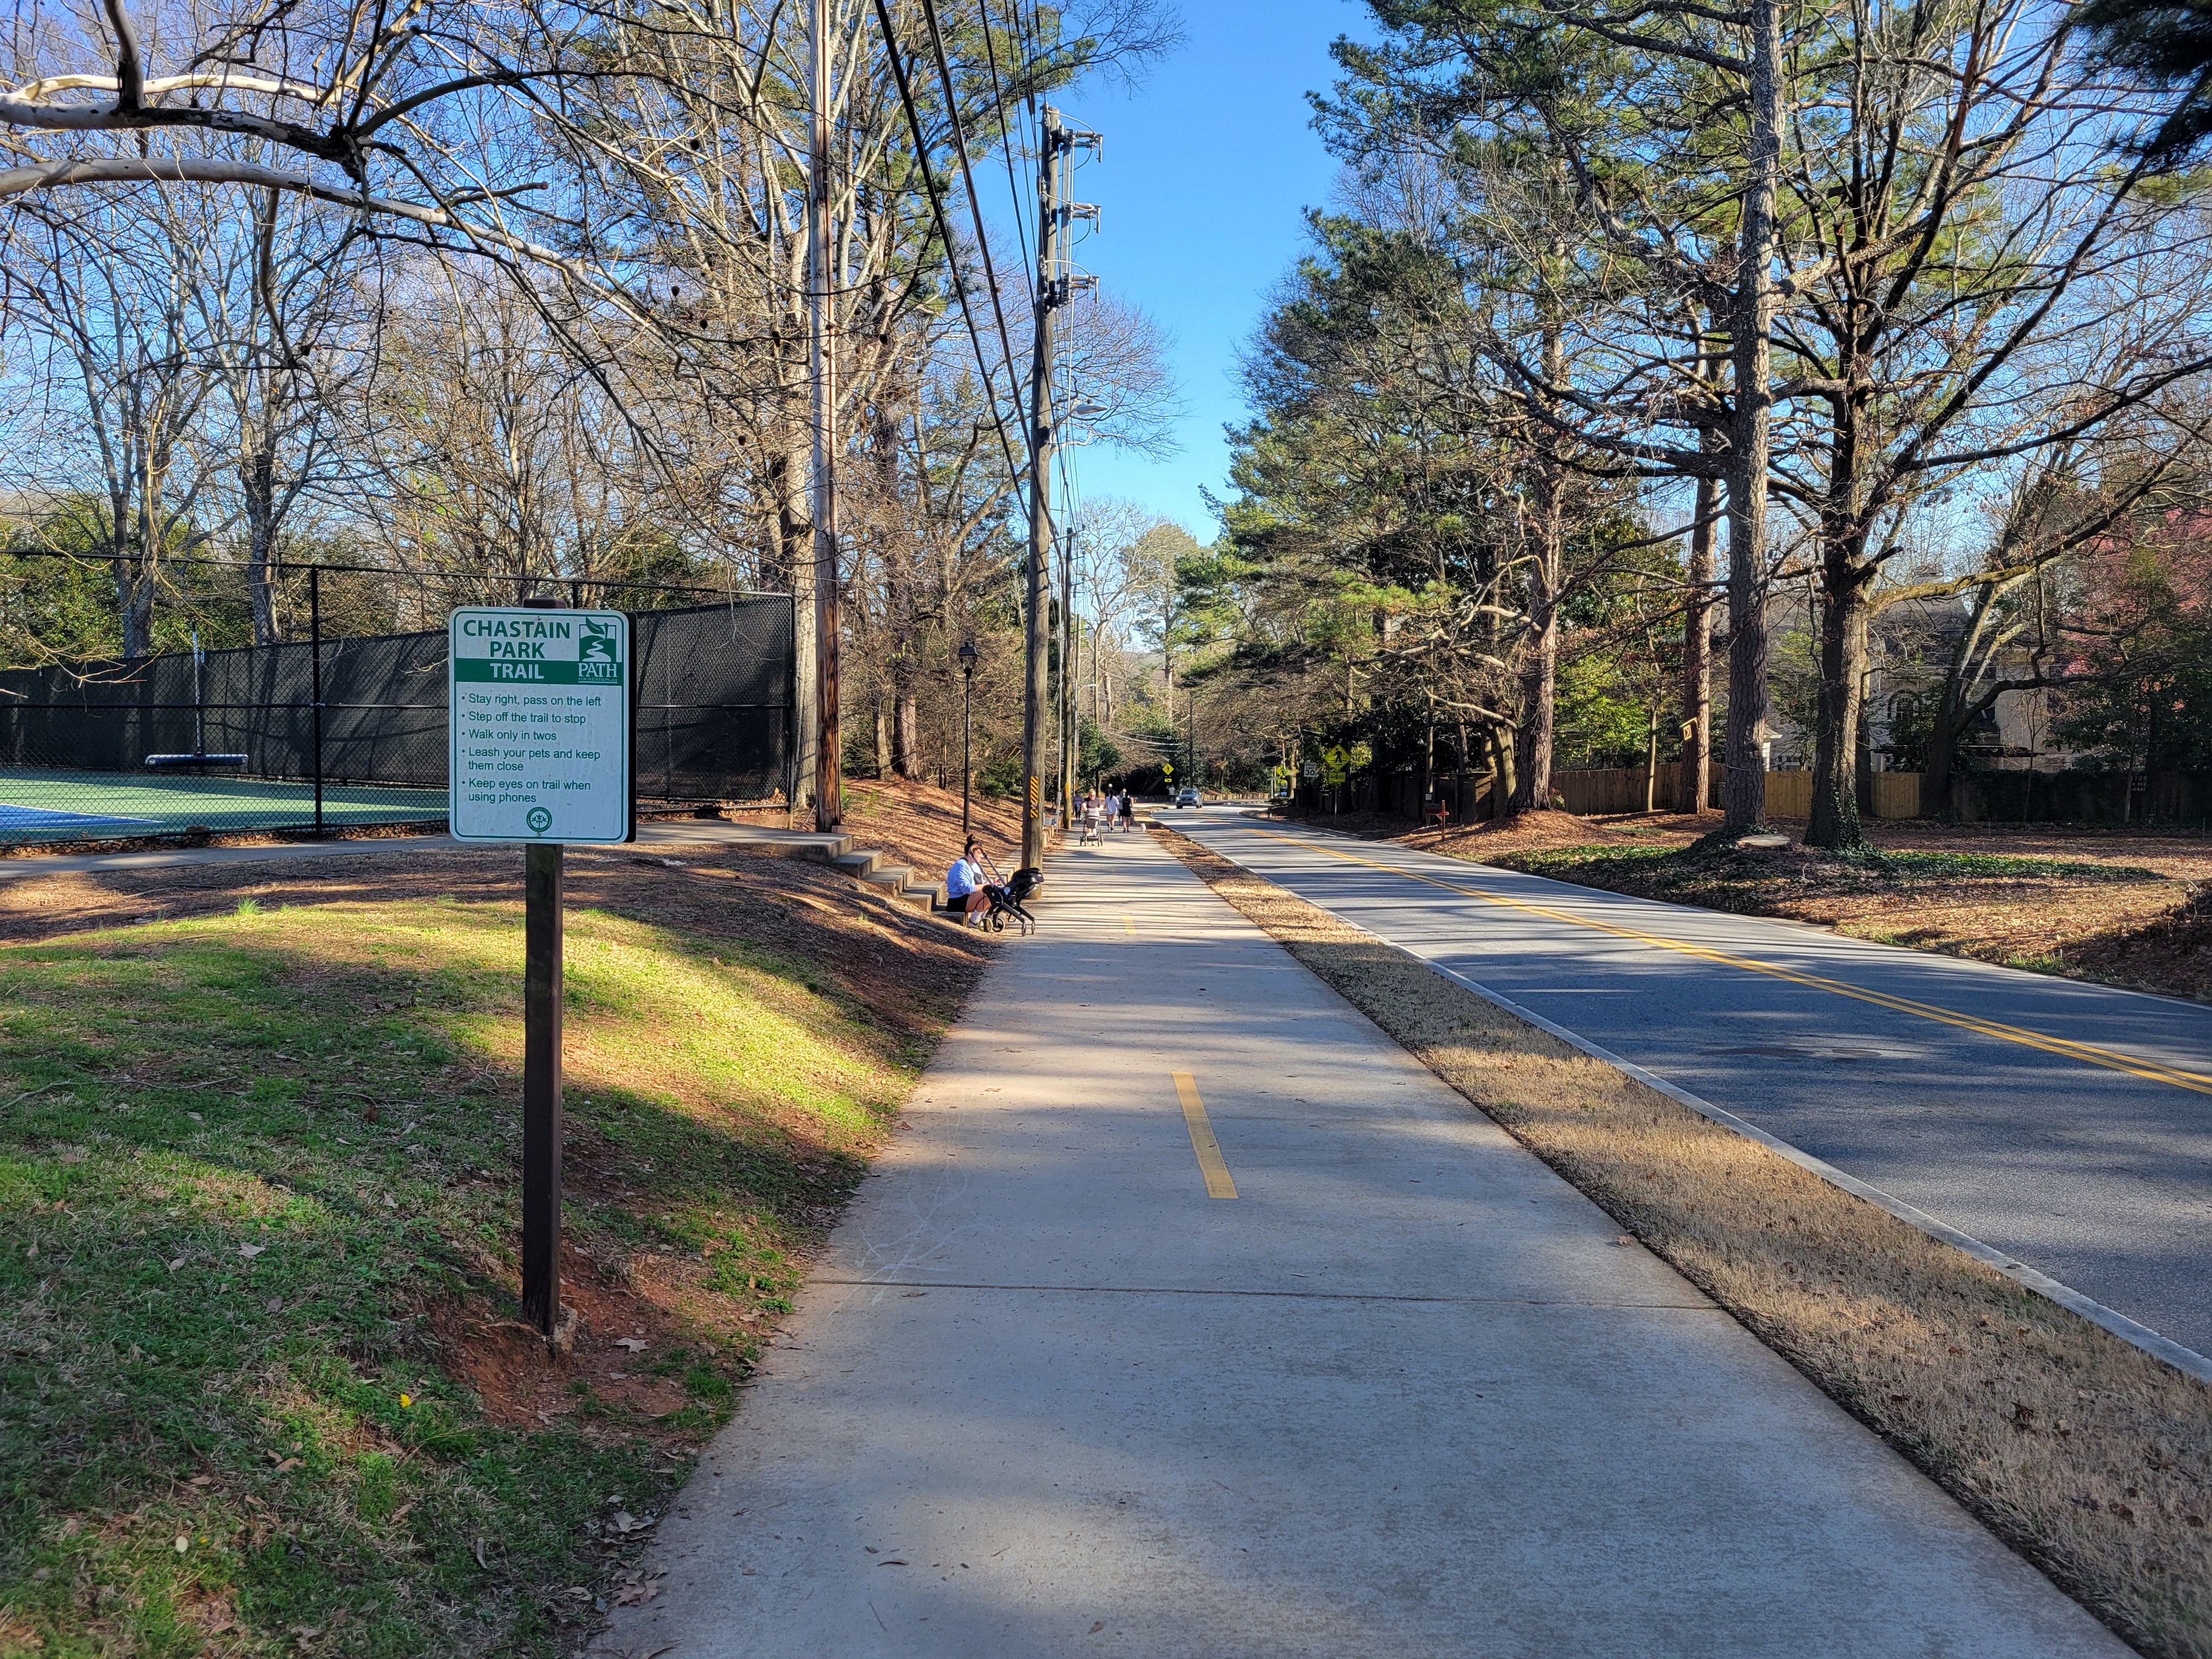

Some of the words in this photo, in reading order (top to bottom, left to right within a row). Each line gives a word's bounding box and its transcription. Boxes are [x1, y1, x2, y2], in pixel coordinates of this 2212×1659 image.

[464, 620, 570, 639] CHASTAIN
[490, 641, 546, 658] PARK
[489, 663, 545, 679] TRAIL
[577, 663, 618, 677] PATH
[469, 693, 492, 706] Stay
[495, 694, 520, 706] right,
[523, 697, 548, 707] pass
[567, 696, 583, 706] the
[586, 696, 601, 706] left
[469, 711, 492, 723] Step
[495, 712, 509, 721] off
[511, 712, 527, 722] the
[530, 713, 549, 723] trail
[551, 713, 561, 723] to
[564, 714, 586, 726] stop
[469, 729, 494, 739] Walk
[497, 730, 518, 742] only
[521, 730, 530, 740] in
[533, 730, 557, 740] twos
[469, 746, 500, 757] Leash
[503, 749, 526, 759] your
[529, 748, 550, 760] pets
[553, 749, 572, 758] and
[575, 749, 601, 761] keep
[468, 760, 494, 770] them
[497, 761, 524, 771] close
[469, 777, 496, 790] Keep
[499, 781, 523, 791] eyes
[541, 780, 560, 789] trail
[563, 780, 591, 790] when
[469, 792, 495, 804] using
[499, 792, 537, 804] phones
